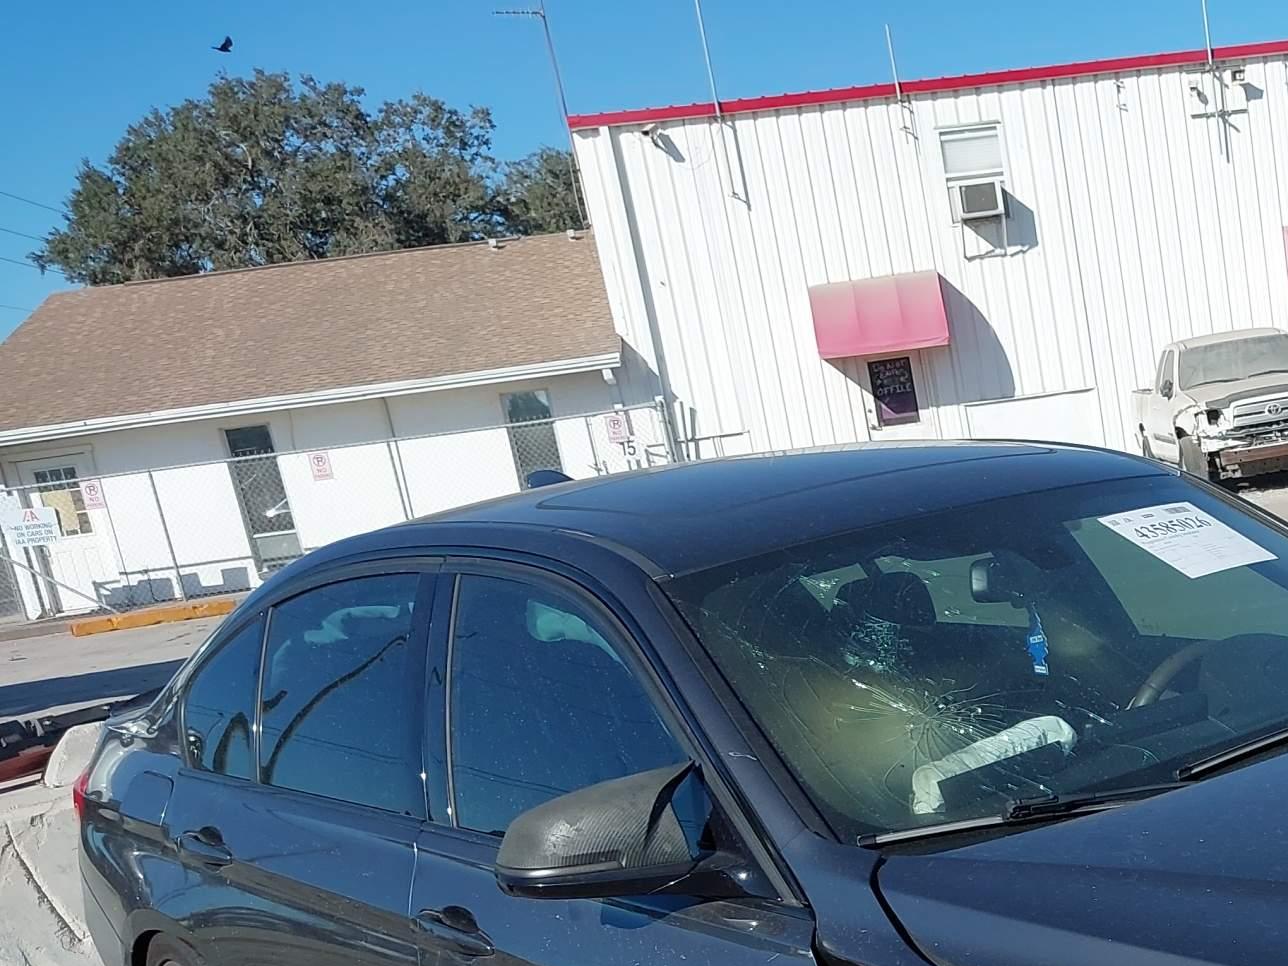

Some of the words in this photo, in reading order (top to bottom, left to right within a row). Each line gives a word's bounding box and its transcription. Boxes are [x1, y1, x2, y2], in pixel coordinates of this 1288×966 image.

[619, 440, 637, 456] 15
[24, 522, 52, 530] WORKING
[1134, 515, 1212, 539] 43585026
[27, 535, 57, 544] PROPERTY
